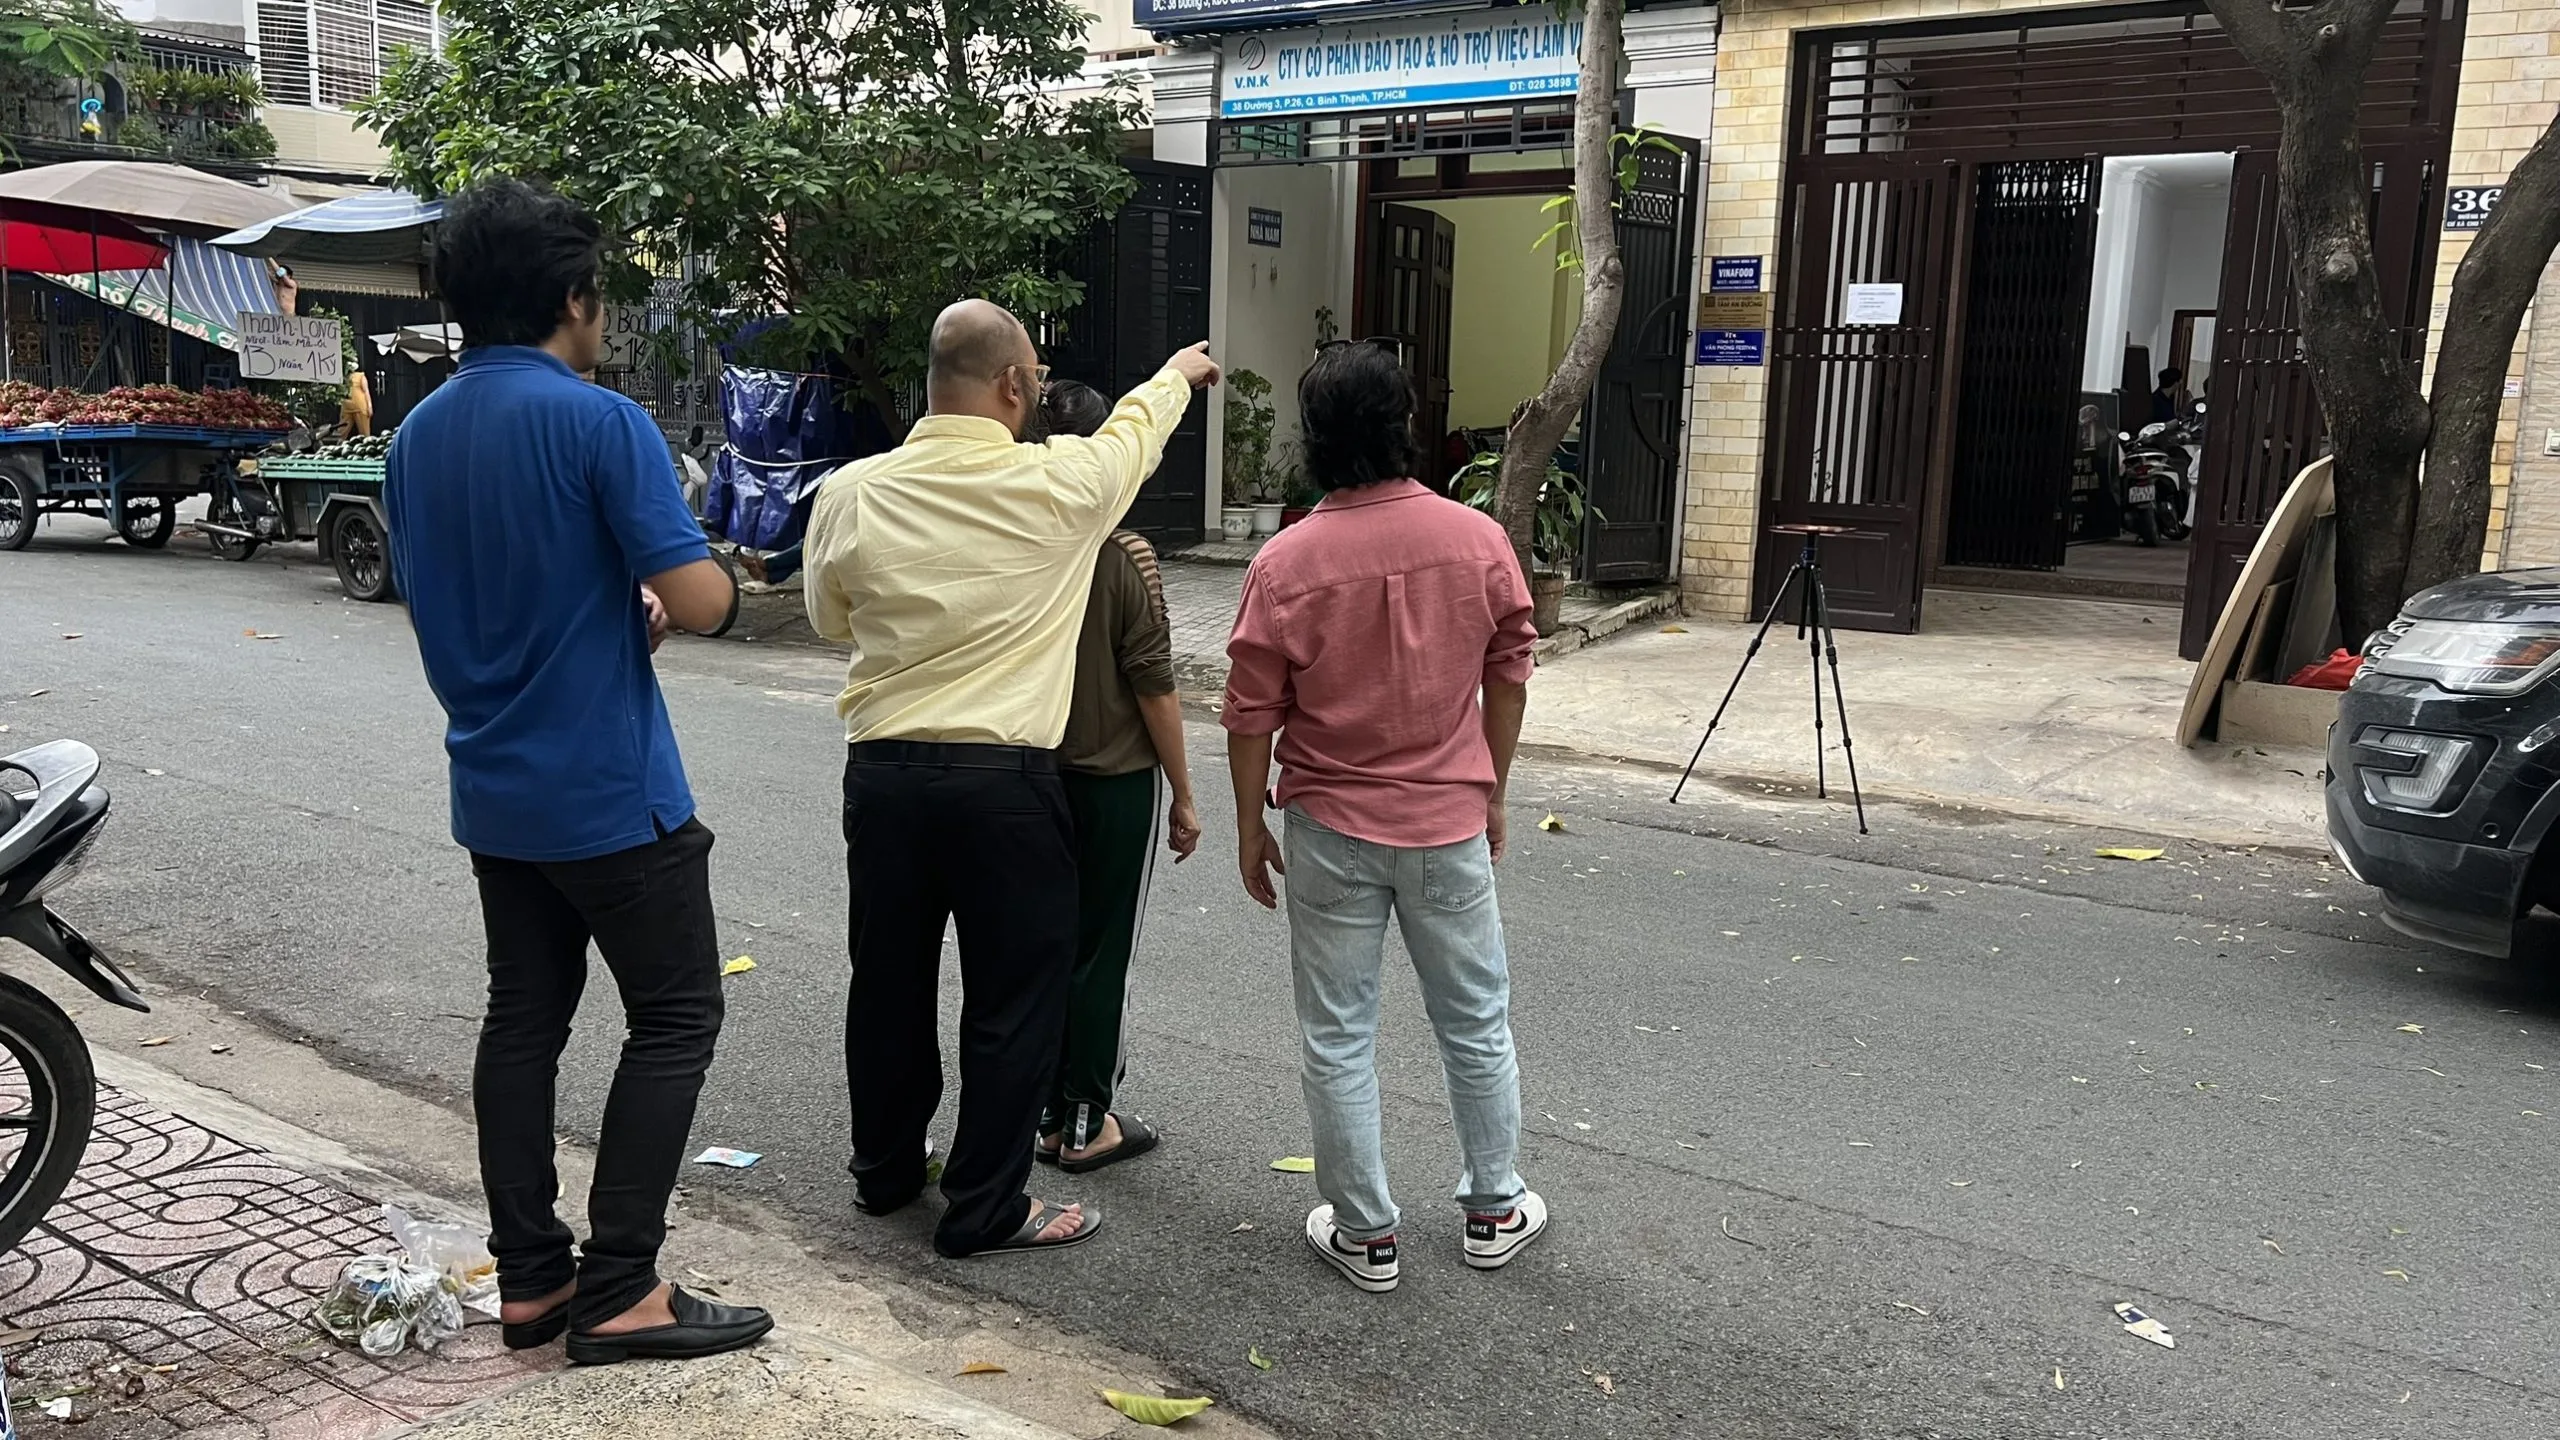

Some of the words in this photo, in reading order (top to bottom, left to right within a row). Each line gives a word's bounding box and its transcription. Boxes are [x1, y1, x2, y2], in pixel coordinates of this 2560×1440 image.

[1278, 48, 1302, 80] CTY
[1306, 29, 1323, 77] CỔ
[1327, 29, 1360, 76] PHẦN
[1365, 32, 1392, 73] ĐÀO
[1396, 36, 1421, 76] TẠO
[1425, 35, 1436, 68] &
[1440, 18, 1459, 67] HỖ
[1464, 24, 1493, 70] TRỢ
[1496, 18, 1529, 68] VIỆC
[1533, 16, 1564, 58] LÀM
[1234, 74, 1269, 89] V.N.K
[1509, 81, 1525, 92] ĐT:
[1528, 79, 1545, 90] 028
[1548, 77, 1571, 88] 3898
[1232, 102, 1242, 112] 38
[1243, 100, 1273, 111] Đường
[1274, 99, 1283, 109] 3,
[1371, 89, 1407, 101] TP.HCM
[1718, 267, 1755, 278] VINAFOOD
[243, 344, 276, 377] 13
[1471, 1223, 1488, 1234] NIKE
[1376, 1247, 1394, 1257] NIKE
